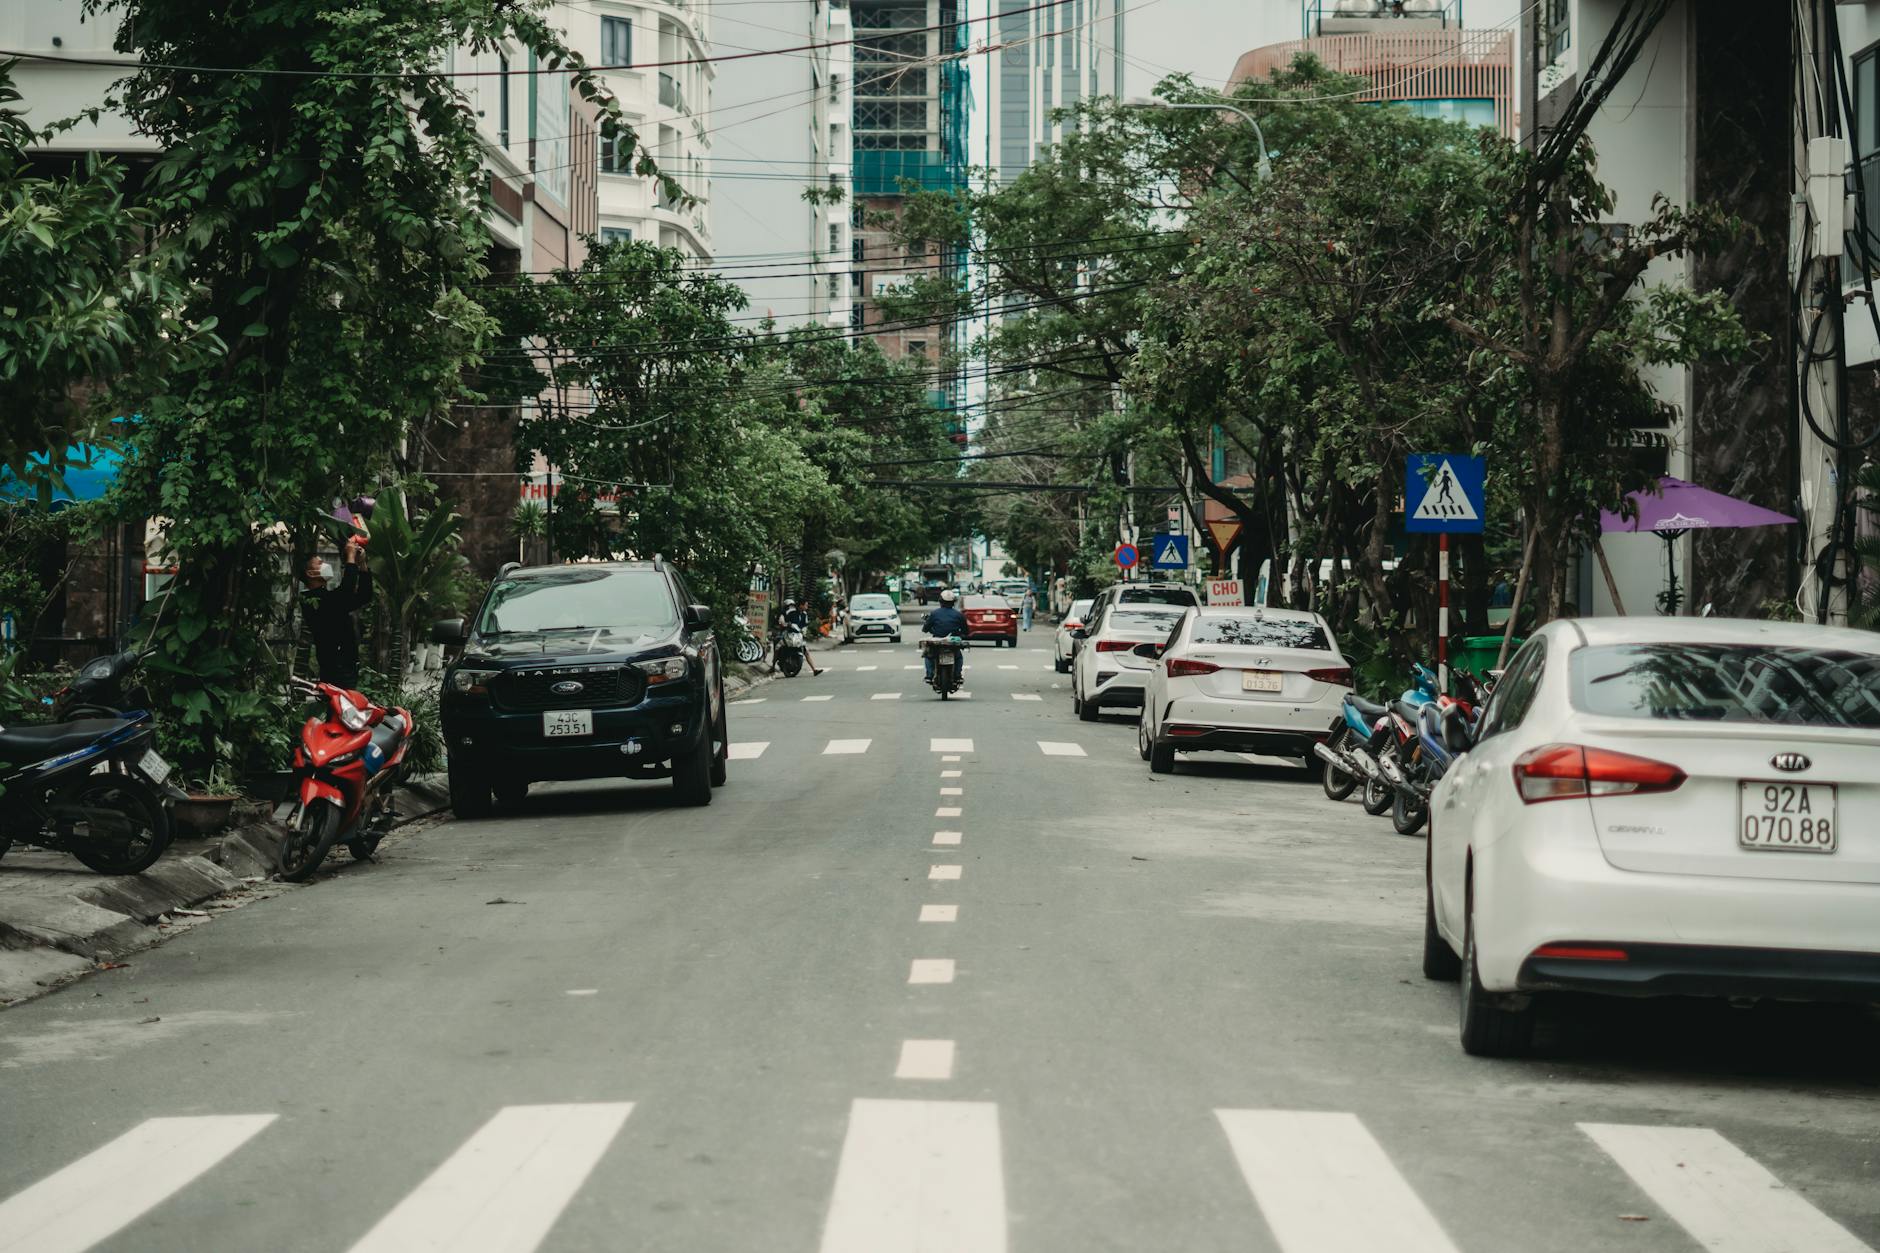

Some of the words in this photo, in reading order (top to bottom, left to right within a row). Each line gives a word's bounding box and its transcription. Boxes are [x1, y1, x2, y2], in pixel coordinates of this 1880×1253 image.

[1212, 581, 1238, 595] CHO
[517, 665, 616, 677] RANGER
[1246, 680, 1278, 690] 013.76
[557, 713, 578, 723] 43C
[549, 723, 587, 735] 253.51
[1776, 755, 1806, 769] KIA
[1764, 785, 1812, 814] 92A
[1744, 815, 1831, 844] 070.88
